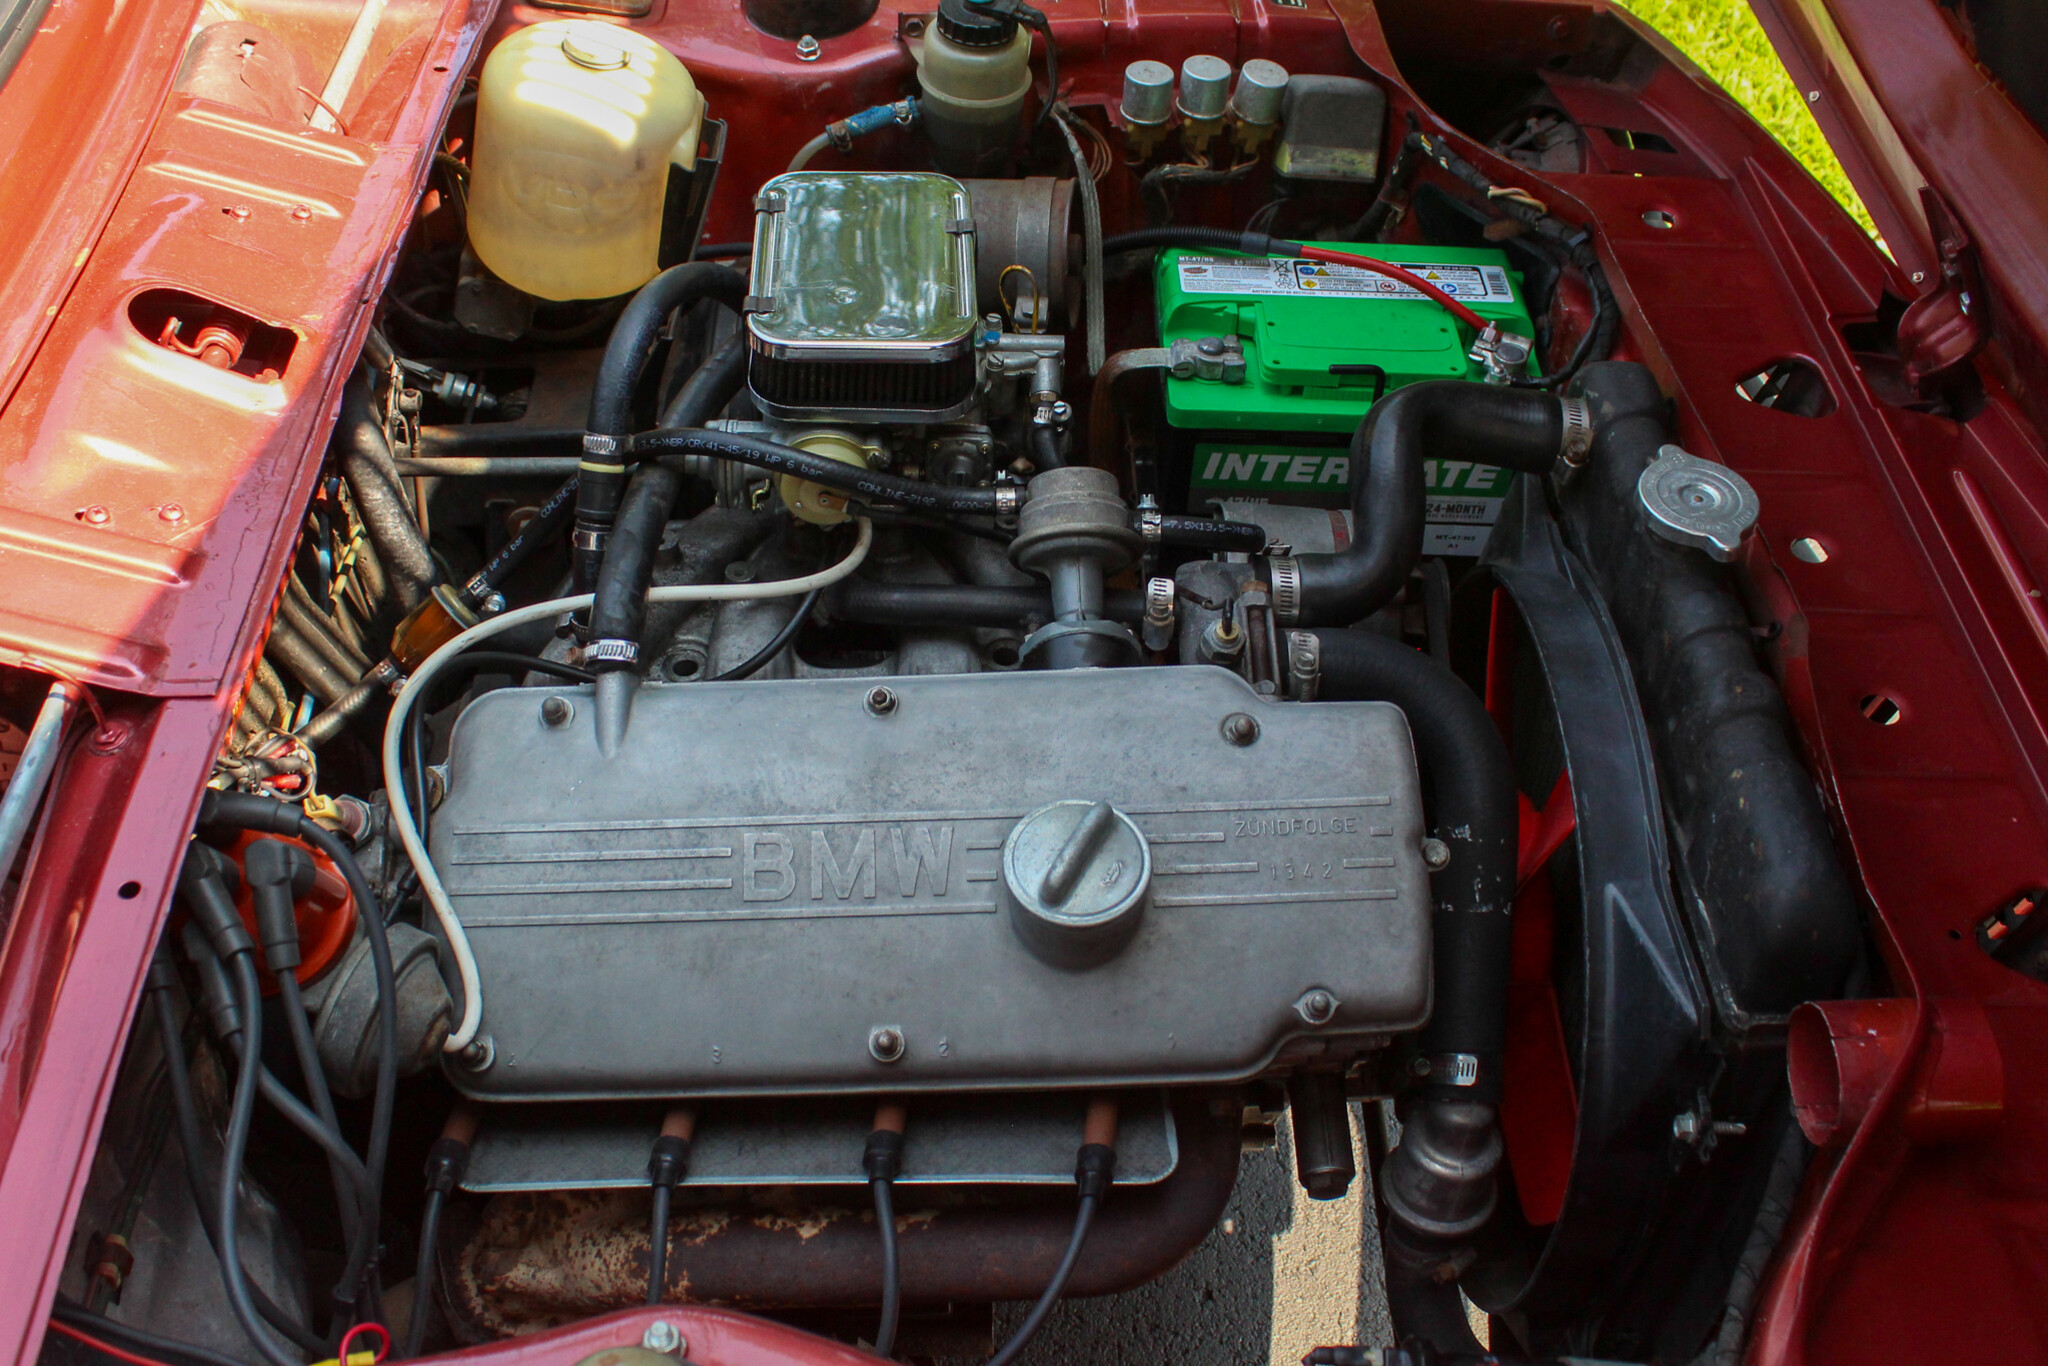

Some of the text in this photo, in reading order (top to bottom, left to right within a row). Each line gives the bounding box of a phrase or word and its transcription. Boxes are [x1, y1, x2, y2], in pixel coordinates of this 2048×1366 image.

[786, 460, 795, 470] 6
[801, 463, 824, 477] bar
[1426, 503, 1486, 515] 24-MONTH
[743, 825, 955, 902] BMW
